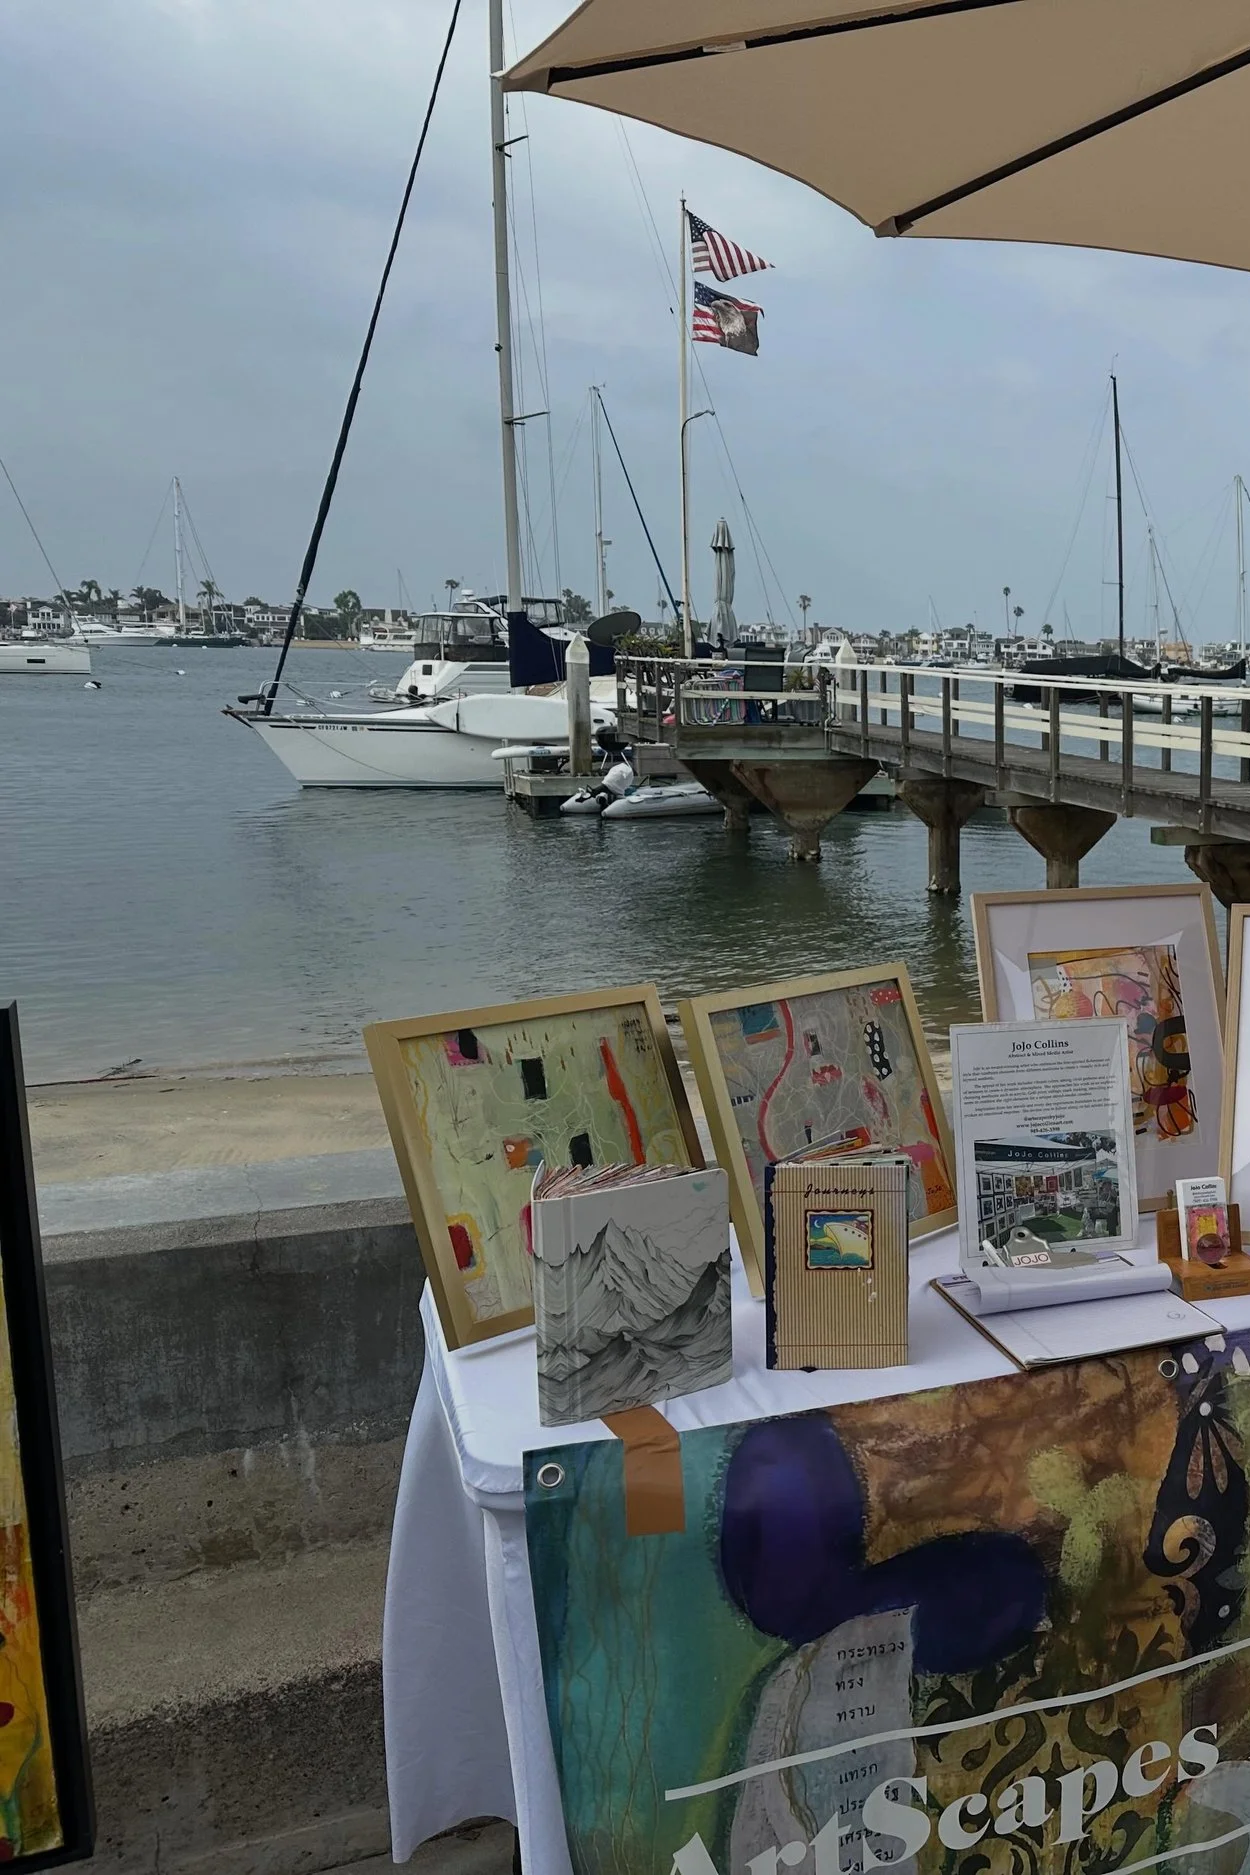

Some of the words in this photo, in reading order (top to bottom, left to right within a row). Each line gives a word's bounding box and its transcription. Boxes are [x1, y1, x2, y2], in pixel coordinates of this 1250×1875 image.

[1012, 1041, 1032, 1052] JoJo
[1034, 1040, 1069, 1049] Collins
[804, 1184, 875, 1198] Journeys
[1014, 1253, 1049, 1266] JOJO
[837, 1641, 905, 1660] กระทรวง
[835, 1677, 864, 1692] ทรง
[836, 1704, 875, 1722] ทราบ
[839, 1763, 878, 1784] แทรก
